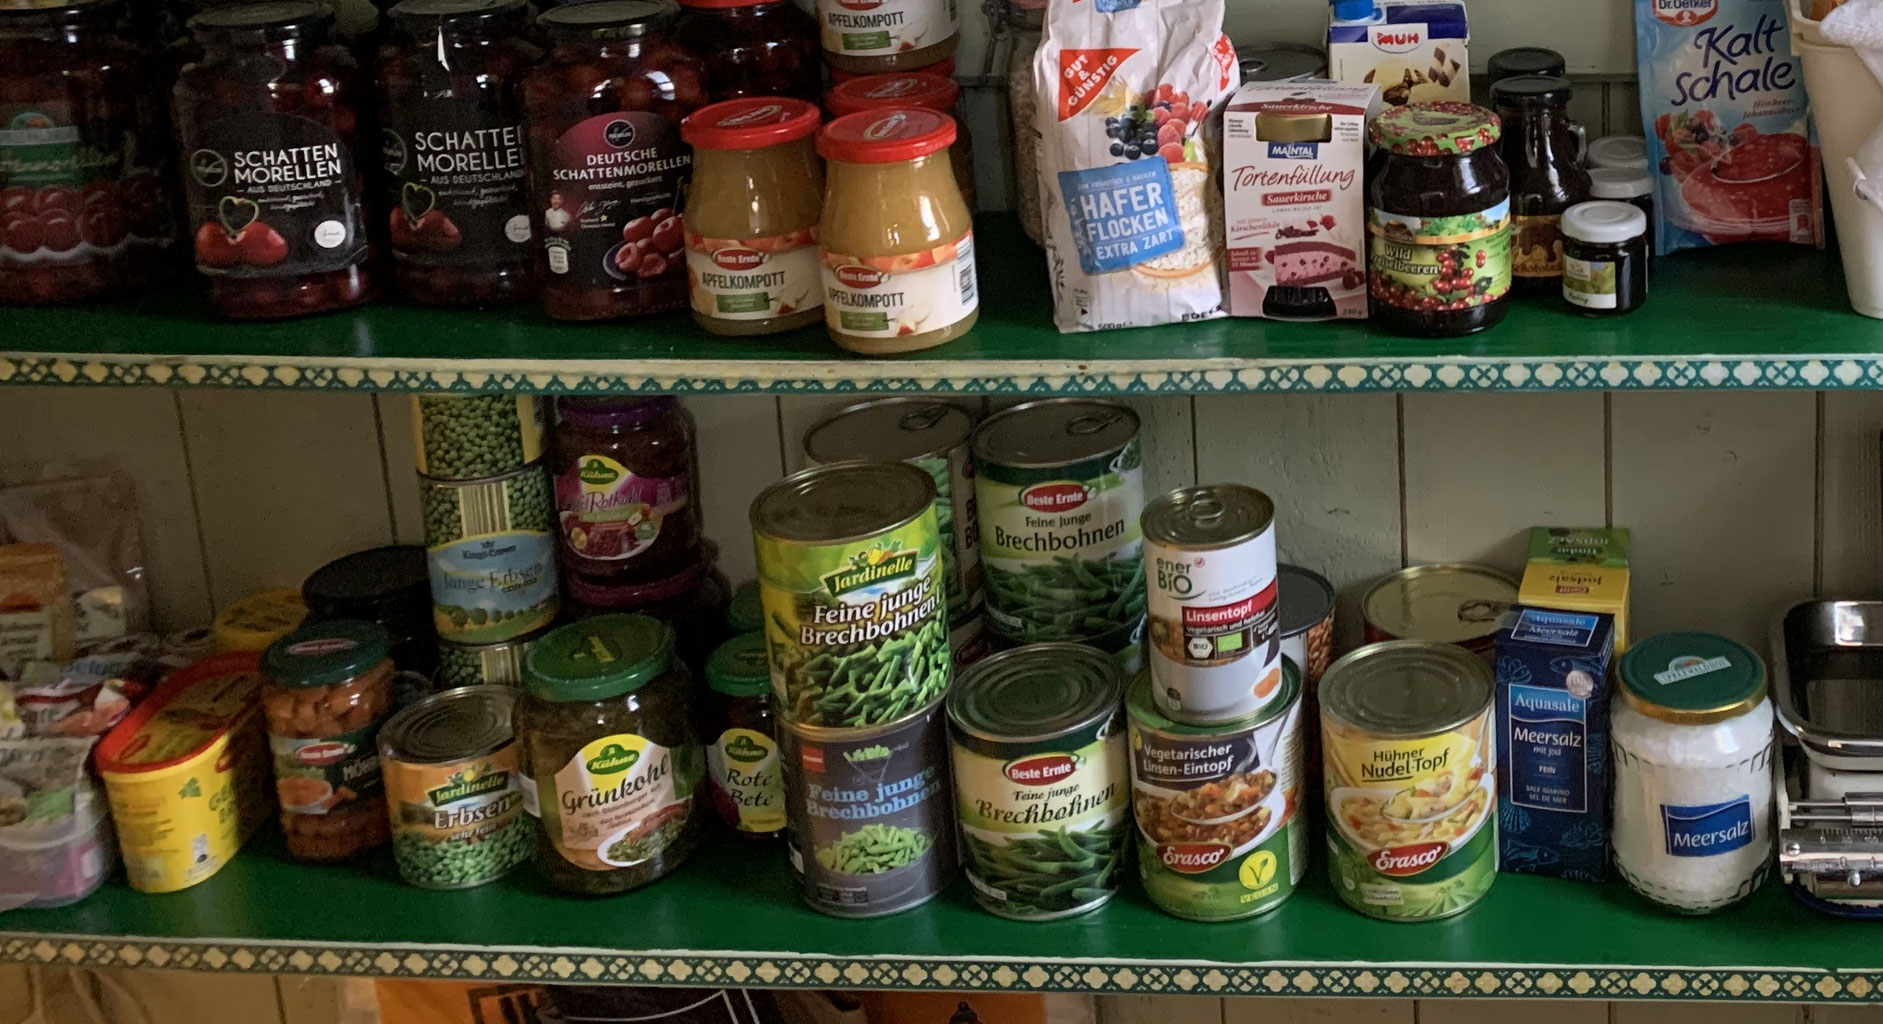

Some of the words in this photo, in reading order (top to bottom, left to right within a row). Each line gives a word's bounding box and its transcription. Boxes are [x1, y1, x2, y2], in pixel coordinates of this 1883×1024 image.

[828, 10, 904, 28] APFELKOMPOTT
[1693, 14, 1784, 68] Kalt
[1064, 54, 1089, 79] GUT
[1078, 70, 1091, 81] &
[1067, 55, 1118, 107] GÜNSTIG
[234, 143, 338, 168] SCHATTEN
[553, 155, 691, 180] SCHATTENMORELLEN
[586, 147, 658, 166] DEUTSCHE
[234, 159, 342, 184] MORELLEN
[1232, 164, 1356, 191] Tortenfüllung
[1080, 182, 1164, 221] HAFER
[1266, 190, 1328, 205] Sauerkirsche
[1086, 207, 1169, 243] FLOCKEN
[1095, 241, 1139, 260] EXTRA
[1142, 229, 1174, 250] ZART
[1384, 243, 1412, 259] Wild
[702, 271, 785, 289] APFELKOMPOTT
[828, 287, 904, 308] APFELKOMPOTT
[1026, 494, 1053, 506] Beste
[1056, 492, 1083, 505] Ernte
[1025, 516, 1056, 527] Feine
[995, 519, 1125, 552] Brechbohnen
[834, 557, 913, 592] Jardinelle
[1156, 557, 1192, 574] ener
[813, 602, 875, 624] Feine
[880, 576, 931, 620] junge
[1186, 600, 1252, 623] Linsentopf
[801, 599, 935, 646] Brechbohnen
[1515, 693, 1580, 713] Aquasale
[1513, 727, 1582, 747] Meersalz
[1143, 743, 1232, 762] Vegetarischer
[1361, 747, 1451, 778] Nudel-Topf
[1373, 747, 1425, 762] Hühner
[1533, 745, 1547, 755] mit
[1012, 767, 1041, 779] Beste
[1043, 763, 1071, 777] Ernte
[1143, 755, 1234, 776] Linsen-Eintopf
[562, 754, 669, 815] Grünkohl
[807, 783, 870, 802] Feine
[874, 766, 935, 803] junge
[1013, 790, 1044, 802] Feine
[1047, 784, 1080, 798] junge
[806, 780, 941, 820] Brechbohnen
[976, 782, 1115, 824] Brechbohnen
[434, 797, 511, 829] Erbsen
[1674, 821, 1749, 847] Meersalz
[1162, 846, 1224, 865] Erasco
[1375, 845, 1442, 871] Erasco
